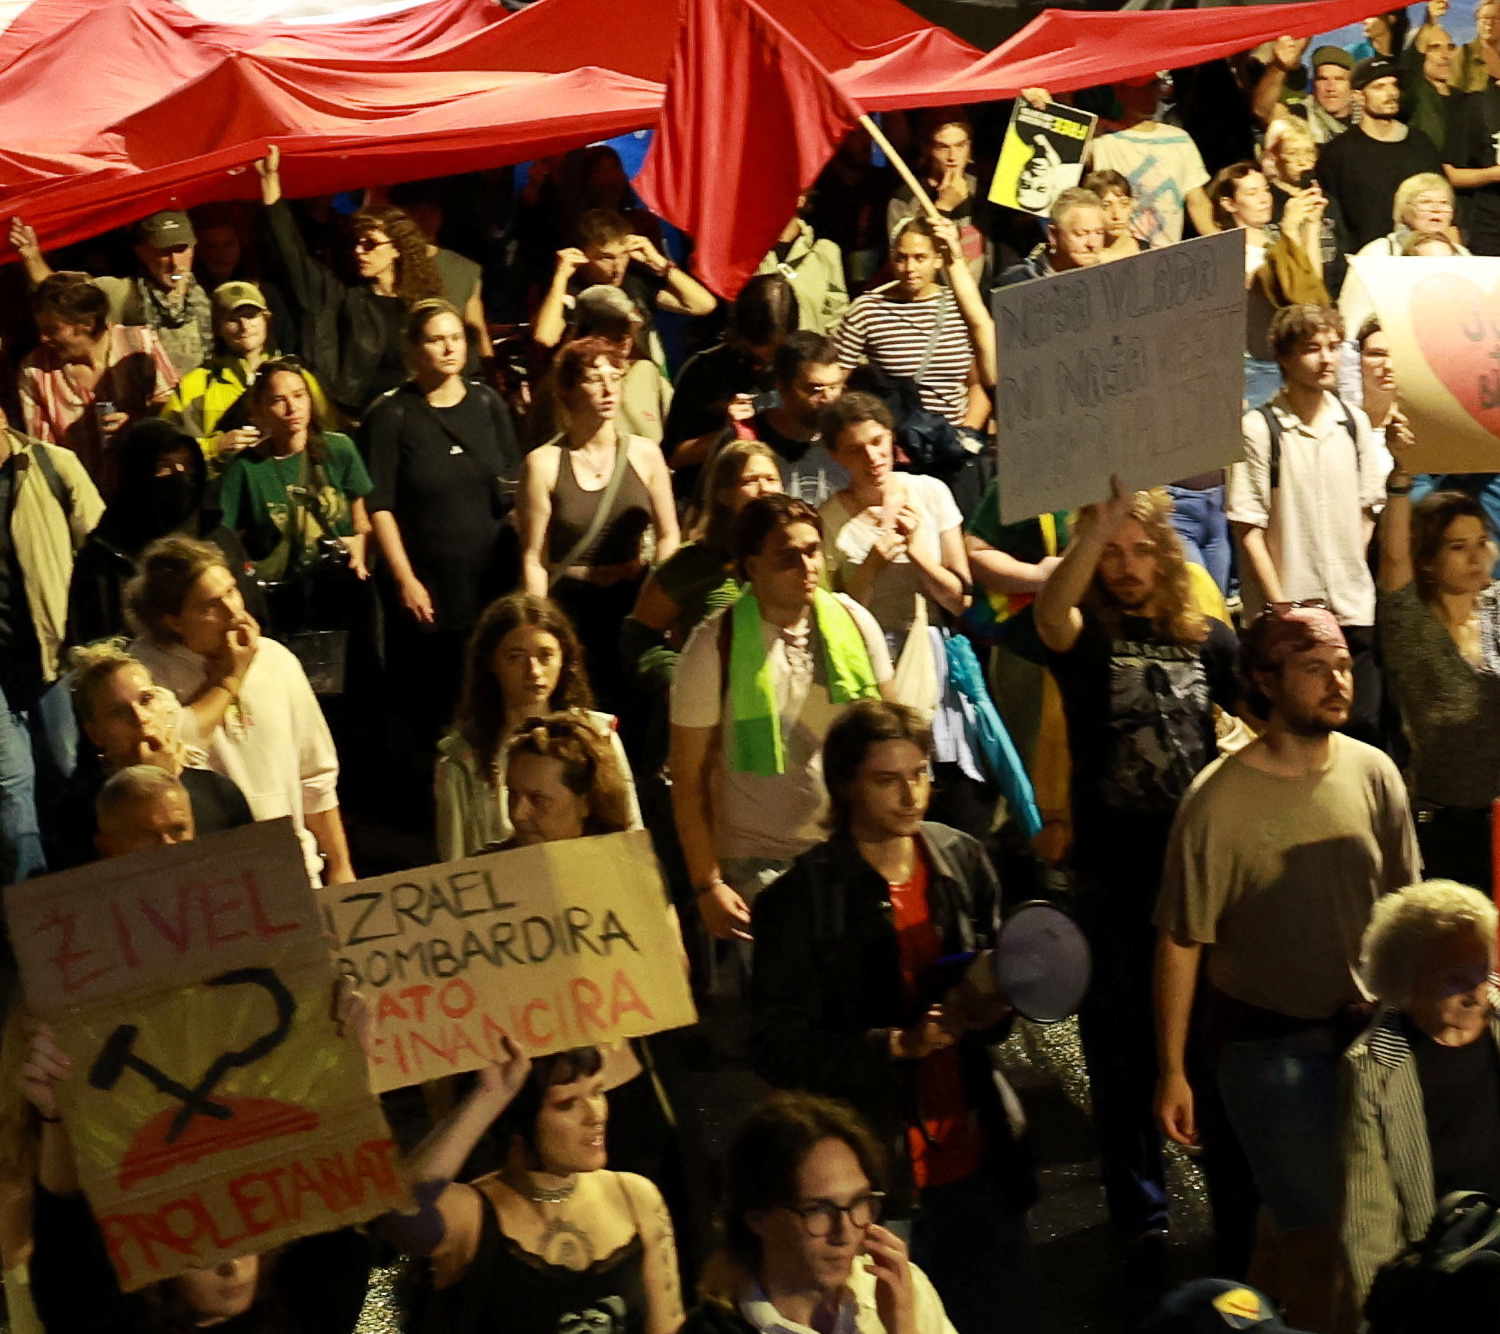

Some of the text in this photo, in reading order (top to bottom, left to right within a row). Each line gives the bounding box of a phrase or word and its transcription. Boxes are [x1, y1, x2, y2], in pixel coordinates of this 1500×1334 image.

[1100, 244, 1219, 323] VLADA
[37, 869, 303, 995] ŽIVEL
[325, 870, 516, 947] IZRAEL
[337, 906, 640, 988] BOMBARDIRA
[374, 978, 478, 1028] ATO
